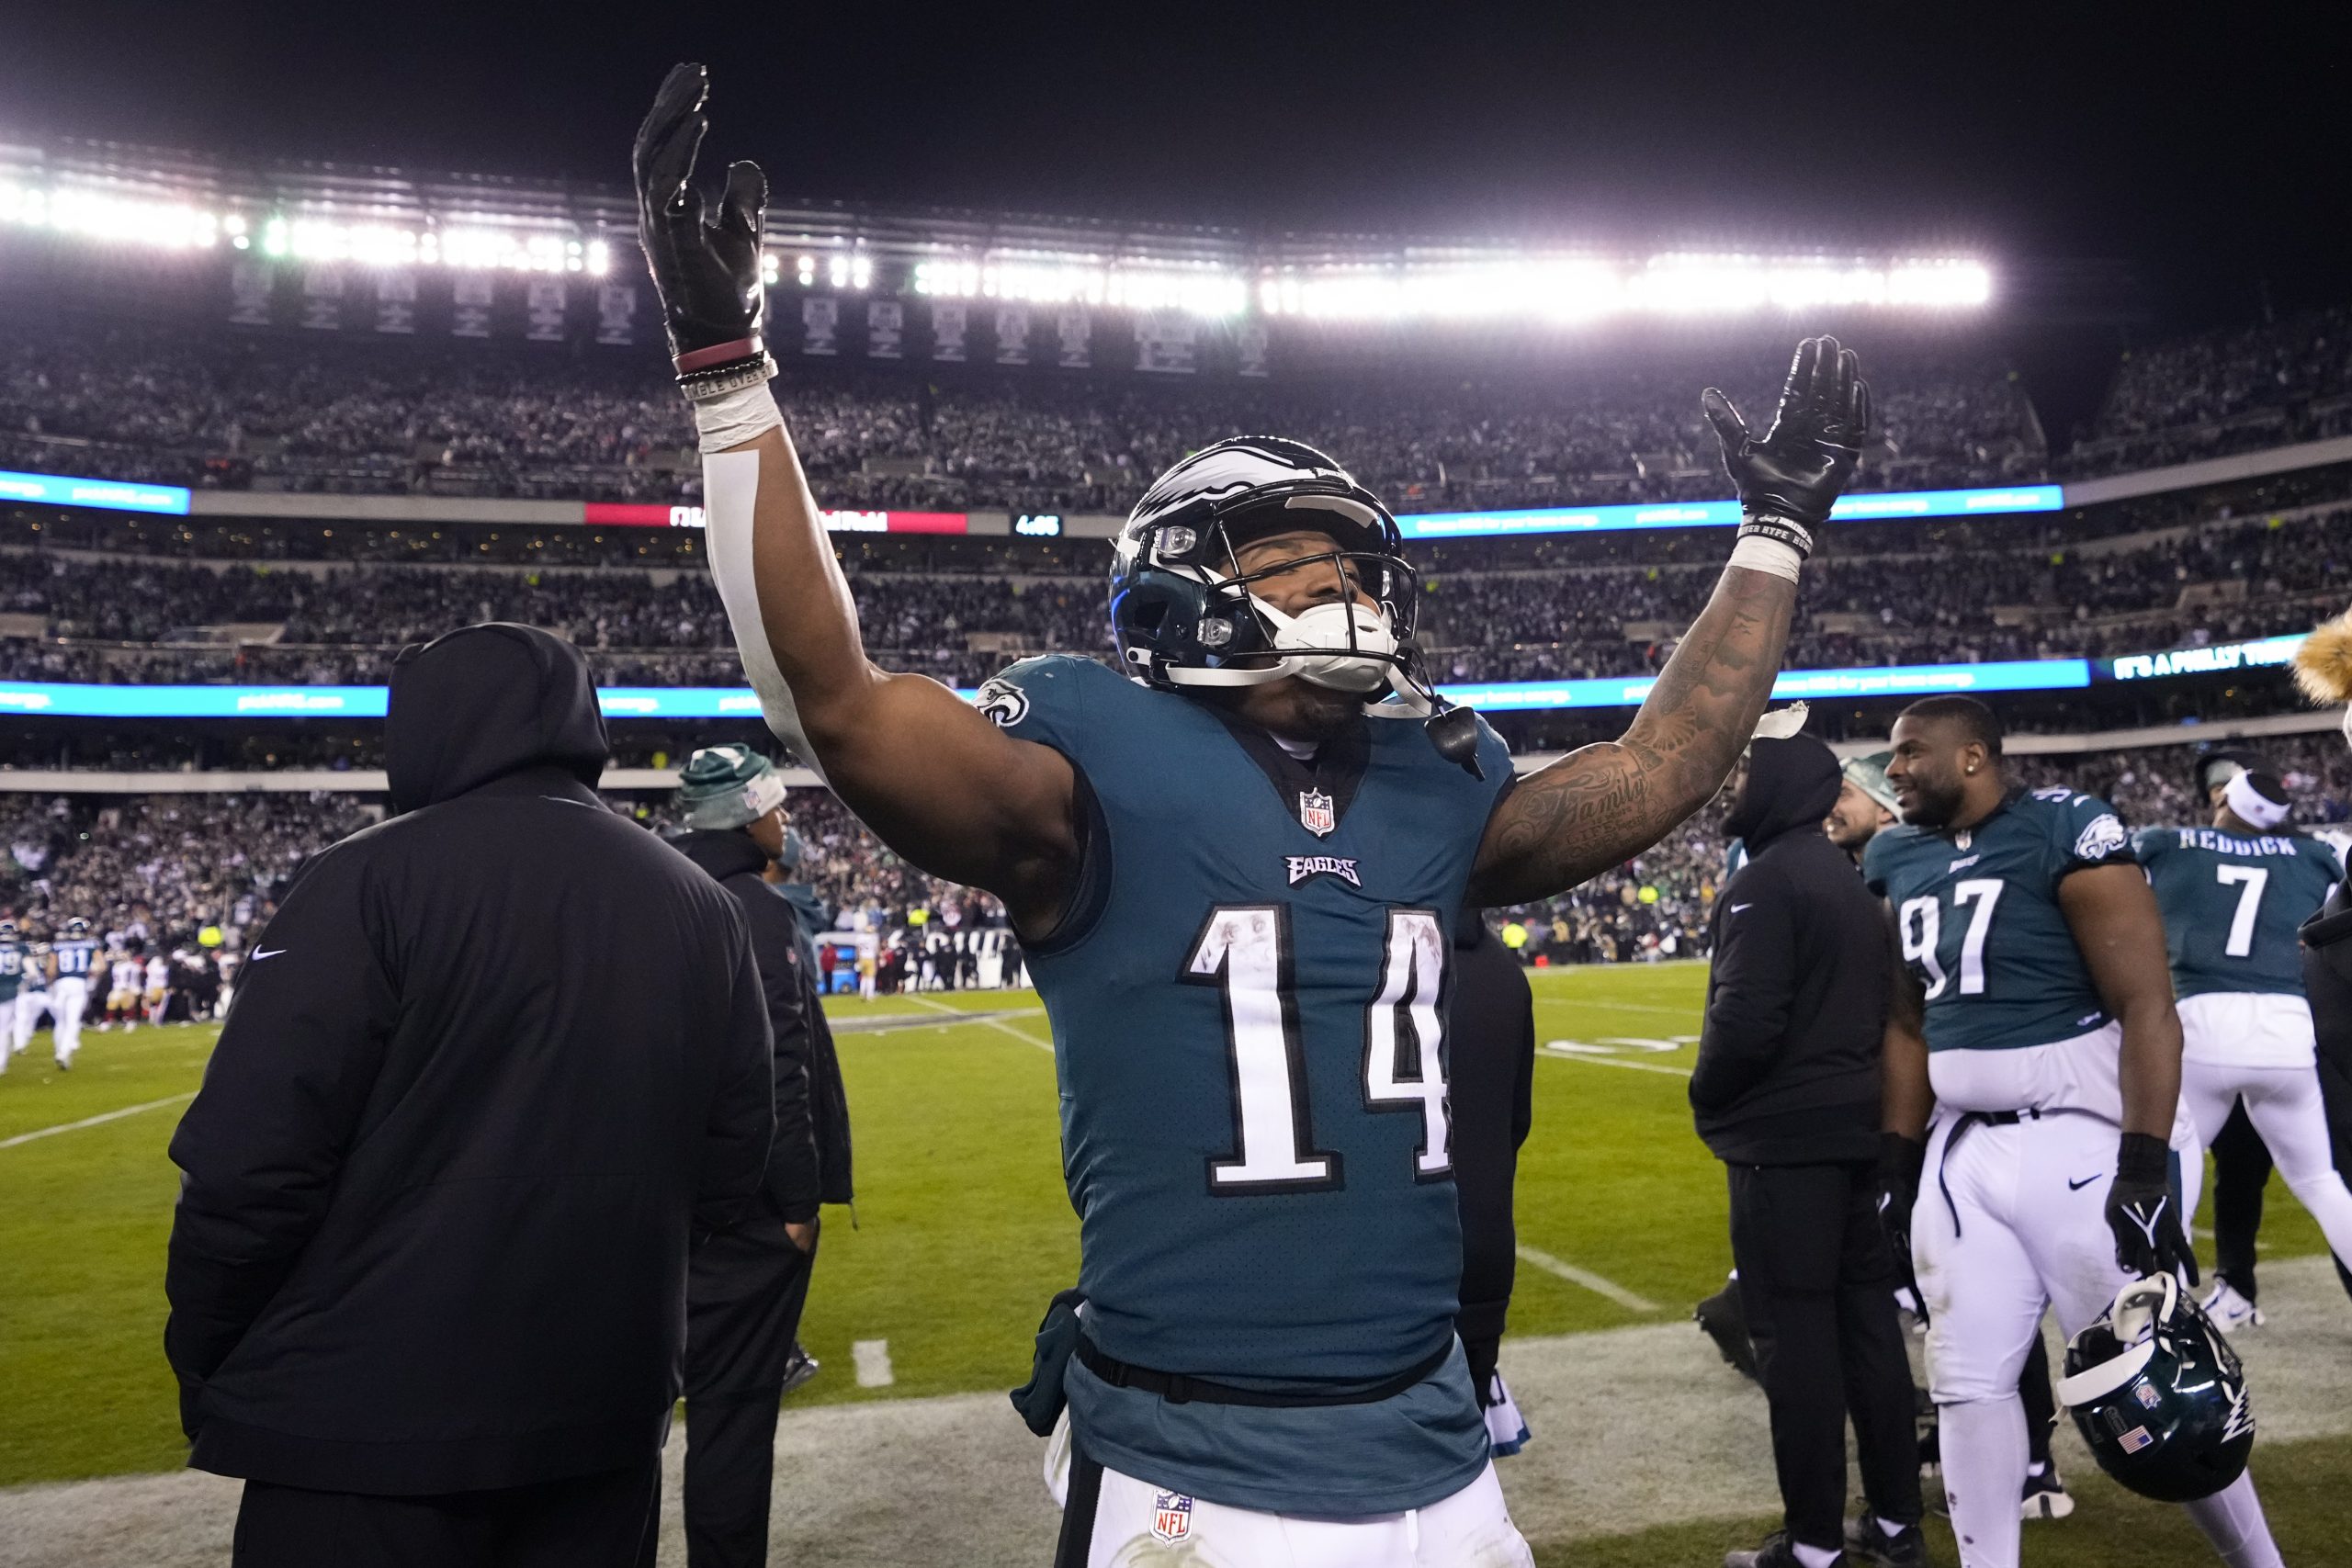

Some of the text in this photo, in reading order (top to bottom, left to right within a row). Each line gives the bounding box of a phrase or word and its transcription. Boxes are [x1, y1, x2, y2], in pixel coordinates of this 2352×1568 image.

[1761, 525, 1790, 540] HYPE
[1307, 808, 1330, 827] NFL
[2178, 828, 2297, 856] REDDICK
[1284, 856, 1362, 887] EAGLES
[2217, 864, 2268, 957] 7
[1900, 879, 2005, 1000] 97
[1182, 904, 1453, 1189] 14
[1158, 1512, 1186, 1535] NFL
